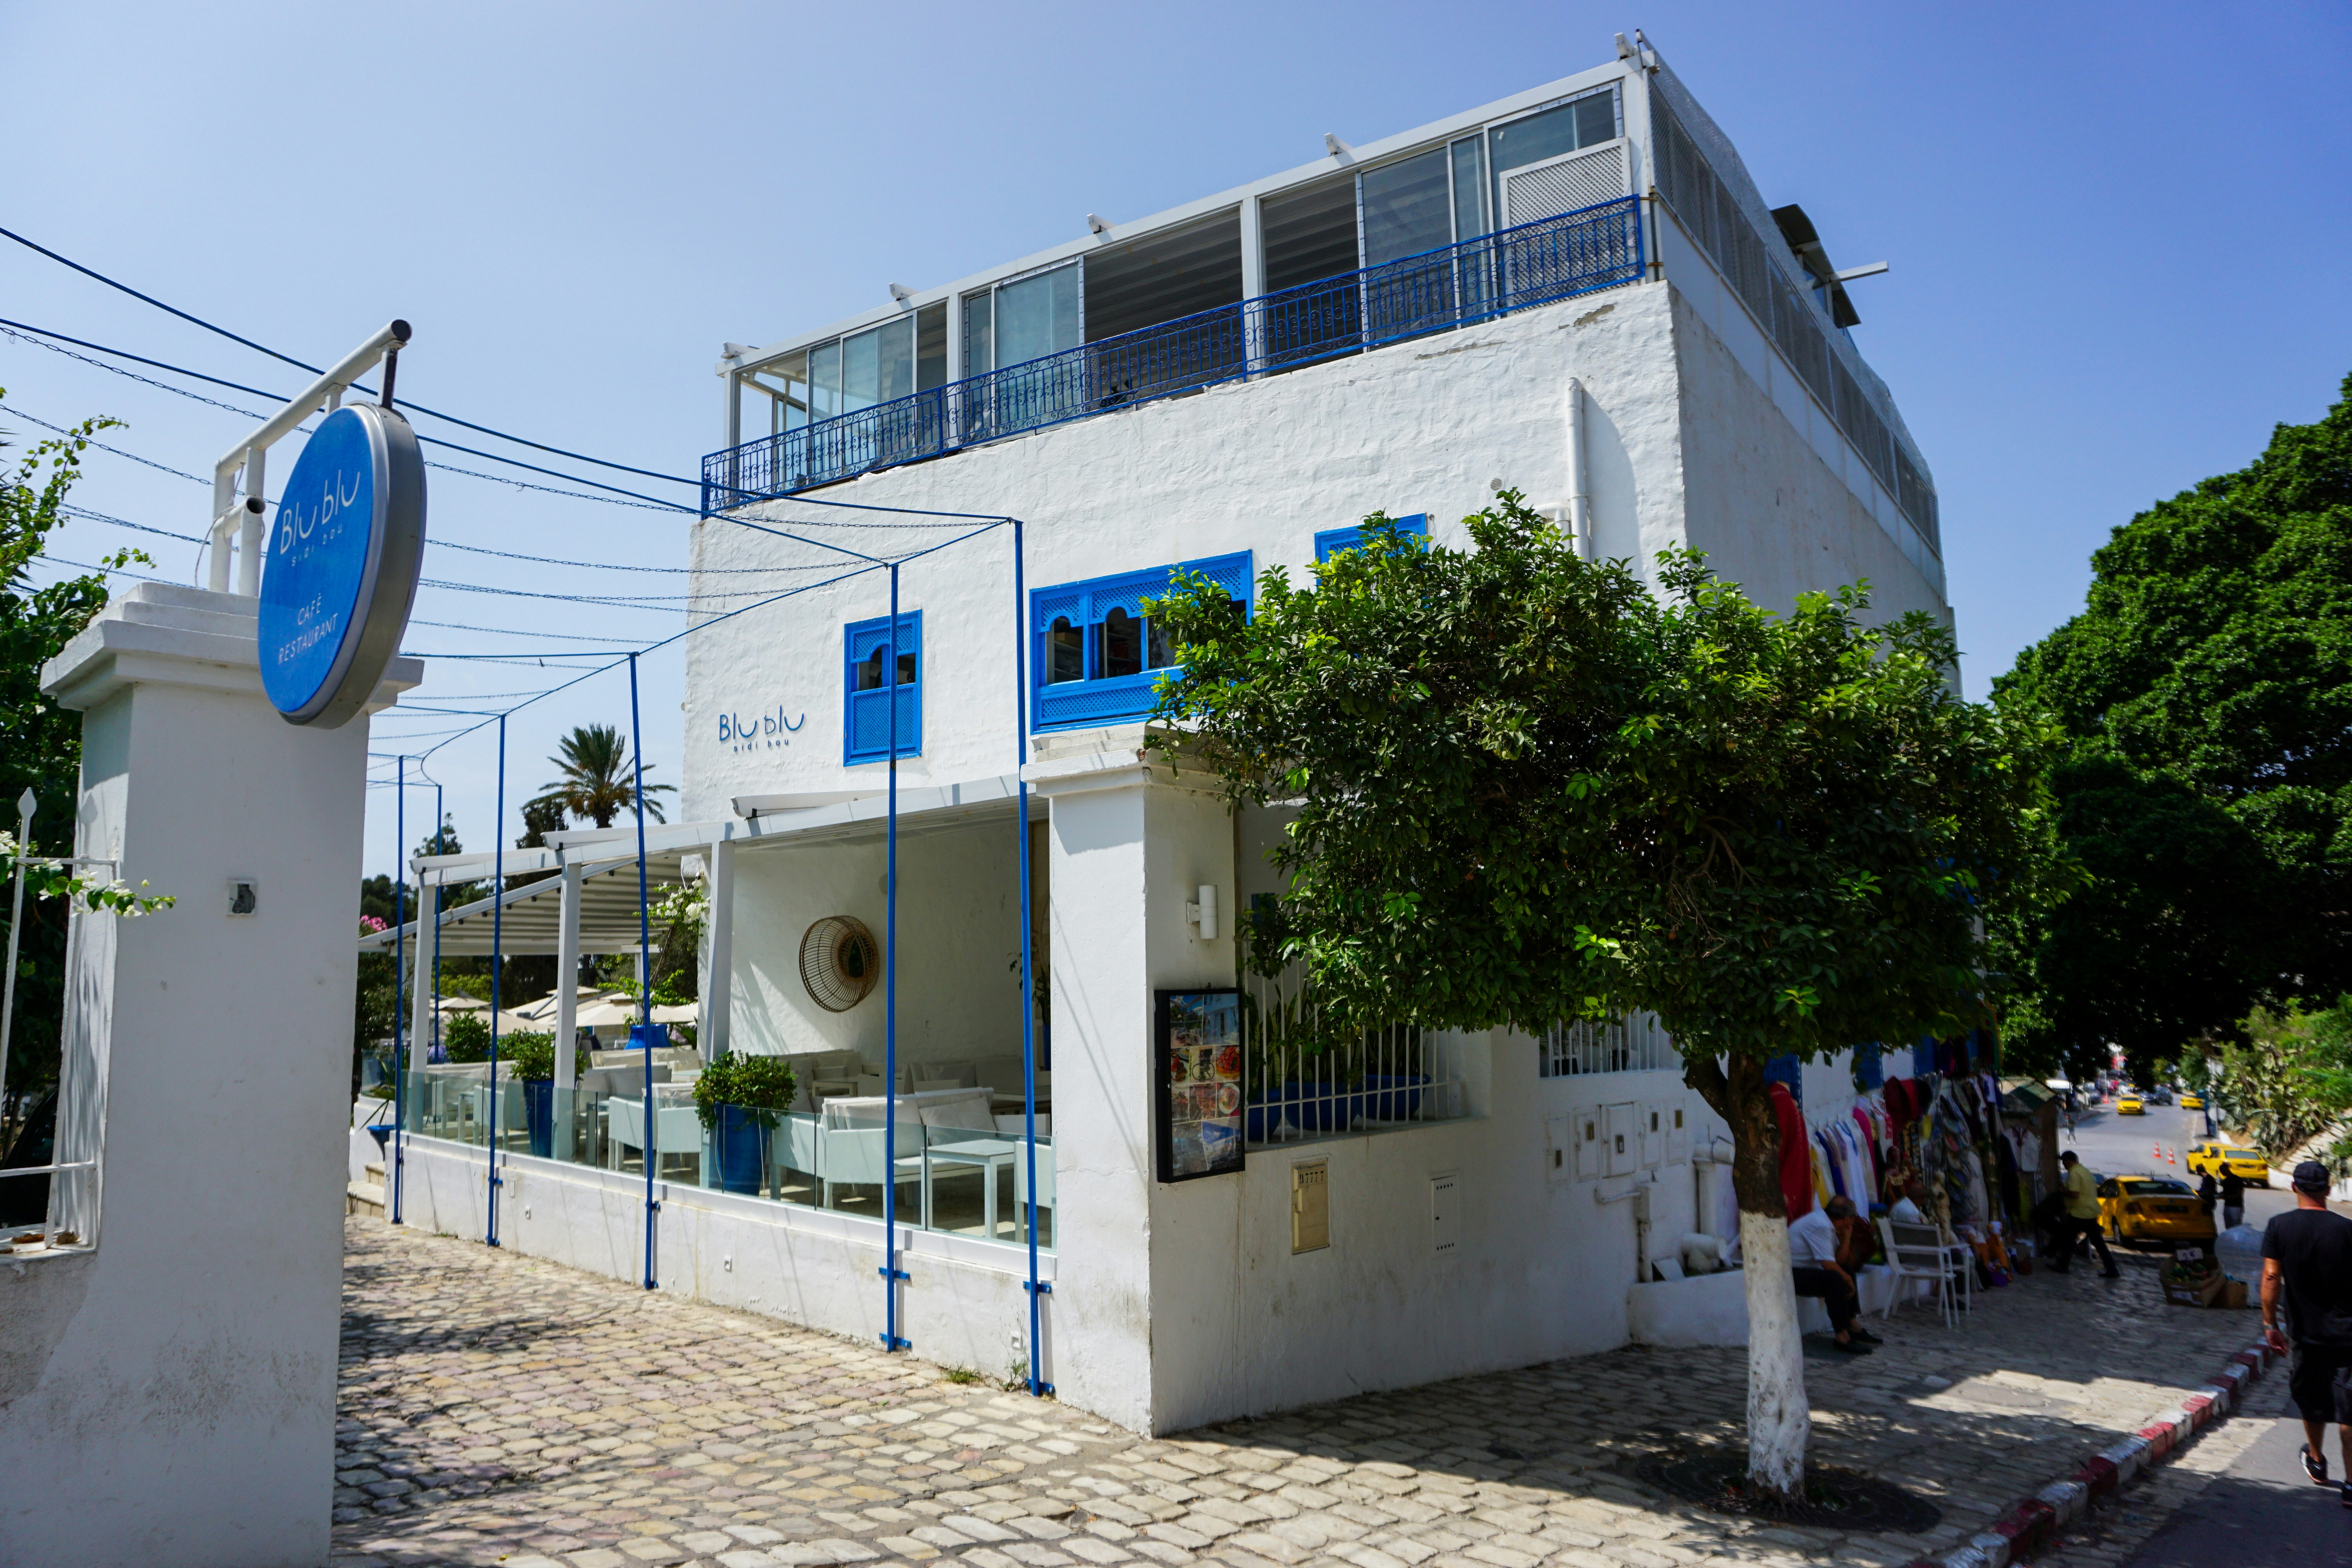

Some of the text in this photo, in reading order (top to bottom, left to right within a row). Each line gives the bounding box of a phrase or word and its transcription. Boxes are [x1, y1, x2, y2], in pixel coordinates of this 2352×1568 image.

[280, 469, 360, 555] Blu blu
[292, 523, 342, 566] sidi bou
[278, 612, 338, 665] RESTAURANT
[719, 705, 804, 741] Blu blu
[733, 739, 789, 752] sidi bou
